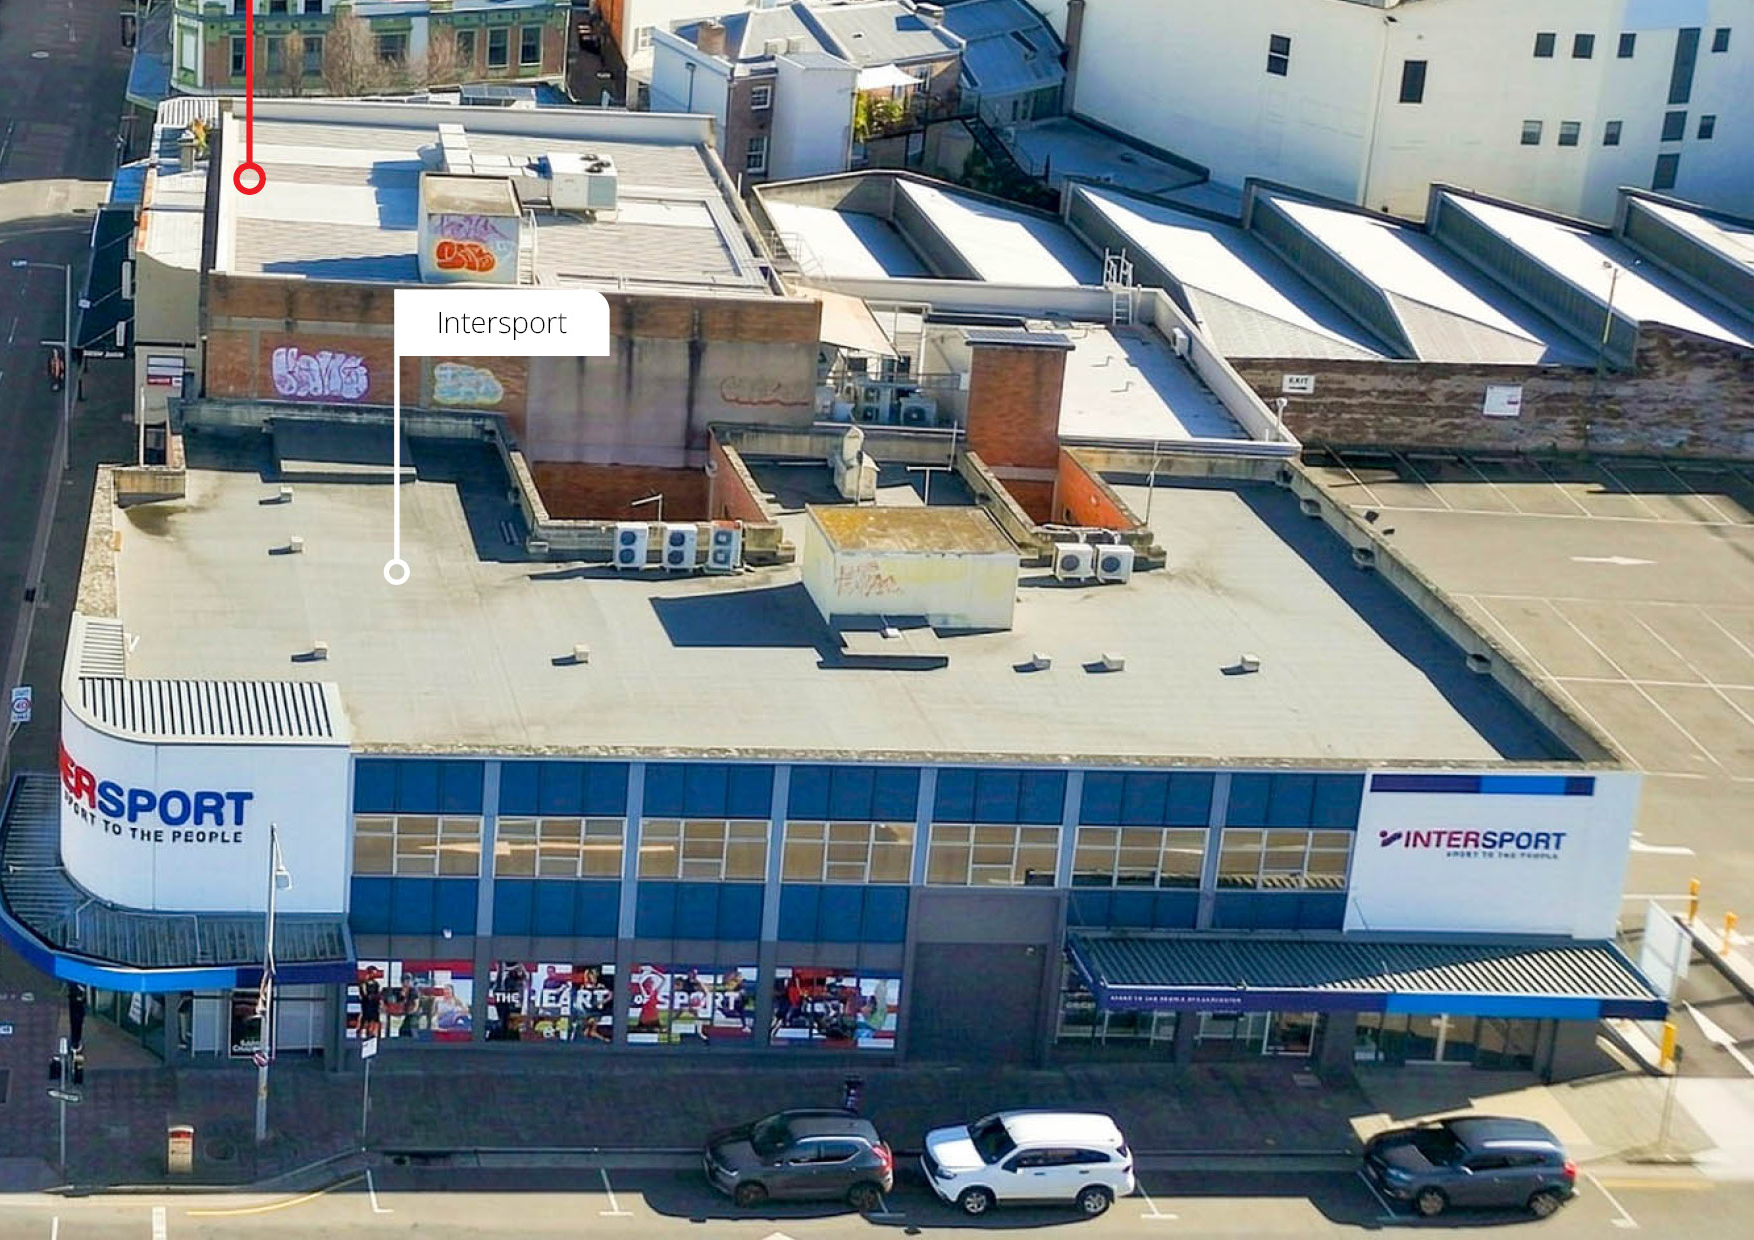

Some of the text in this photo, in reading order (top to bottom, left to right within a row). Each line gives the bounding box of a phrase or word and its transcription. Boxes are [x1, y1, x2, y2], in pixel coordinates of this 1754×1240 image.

[59, 745, 255, 827] ERSPORT
[103, 820, 121, 836] TO
[129, 827, 164, 843] THE
[172, 830, 243, 844] PEOPLE
[1404, 831, 1566, 850] INTERSPORT
[495, 992, 521, 1008] THE
[656, 990, 740, 1010] SPORT
